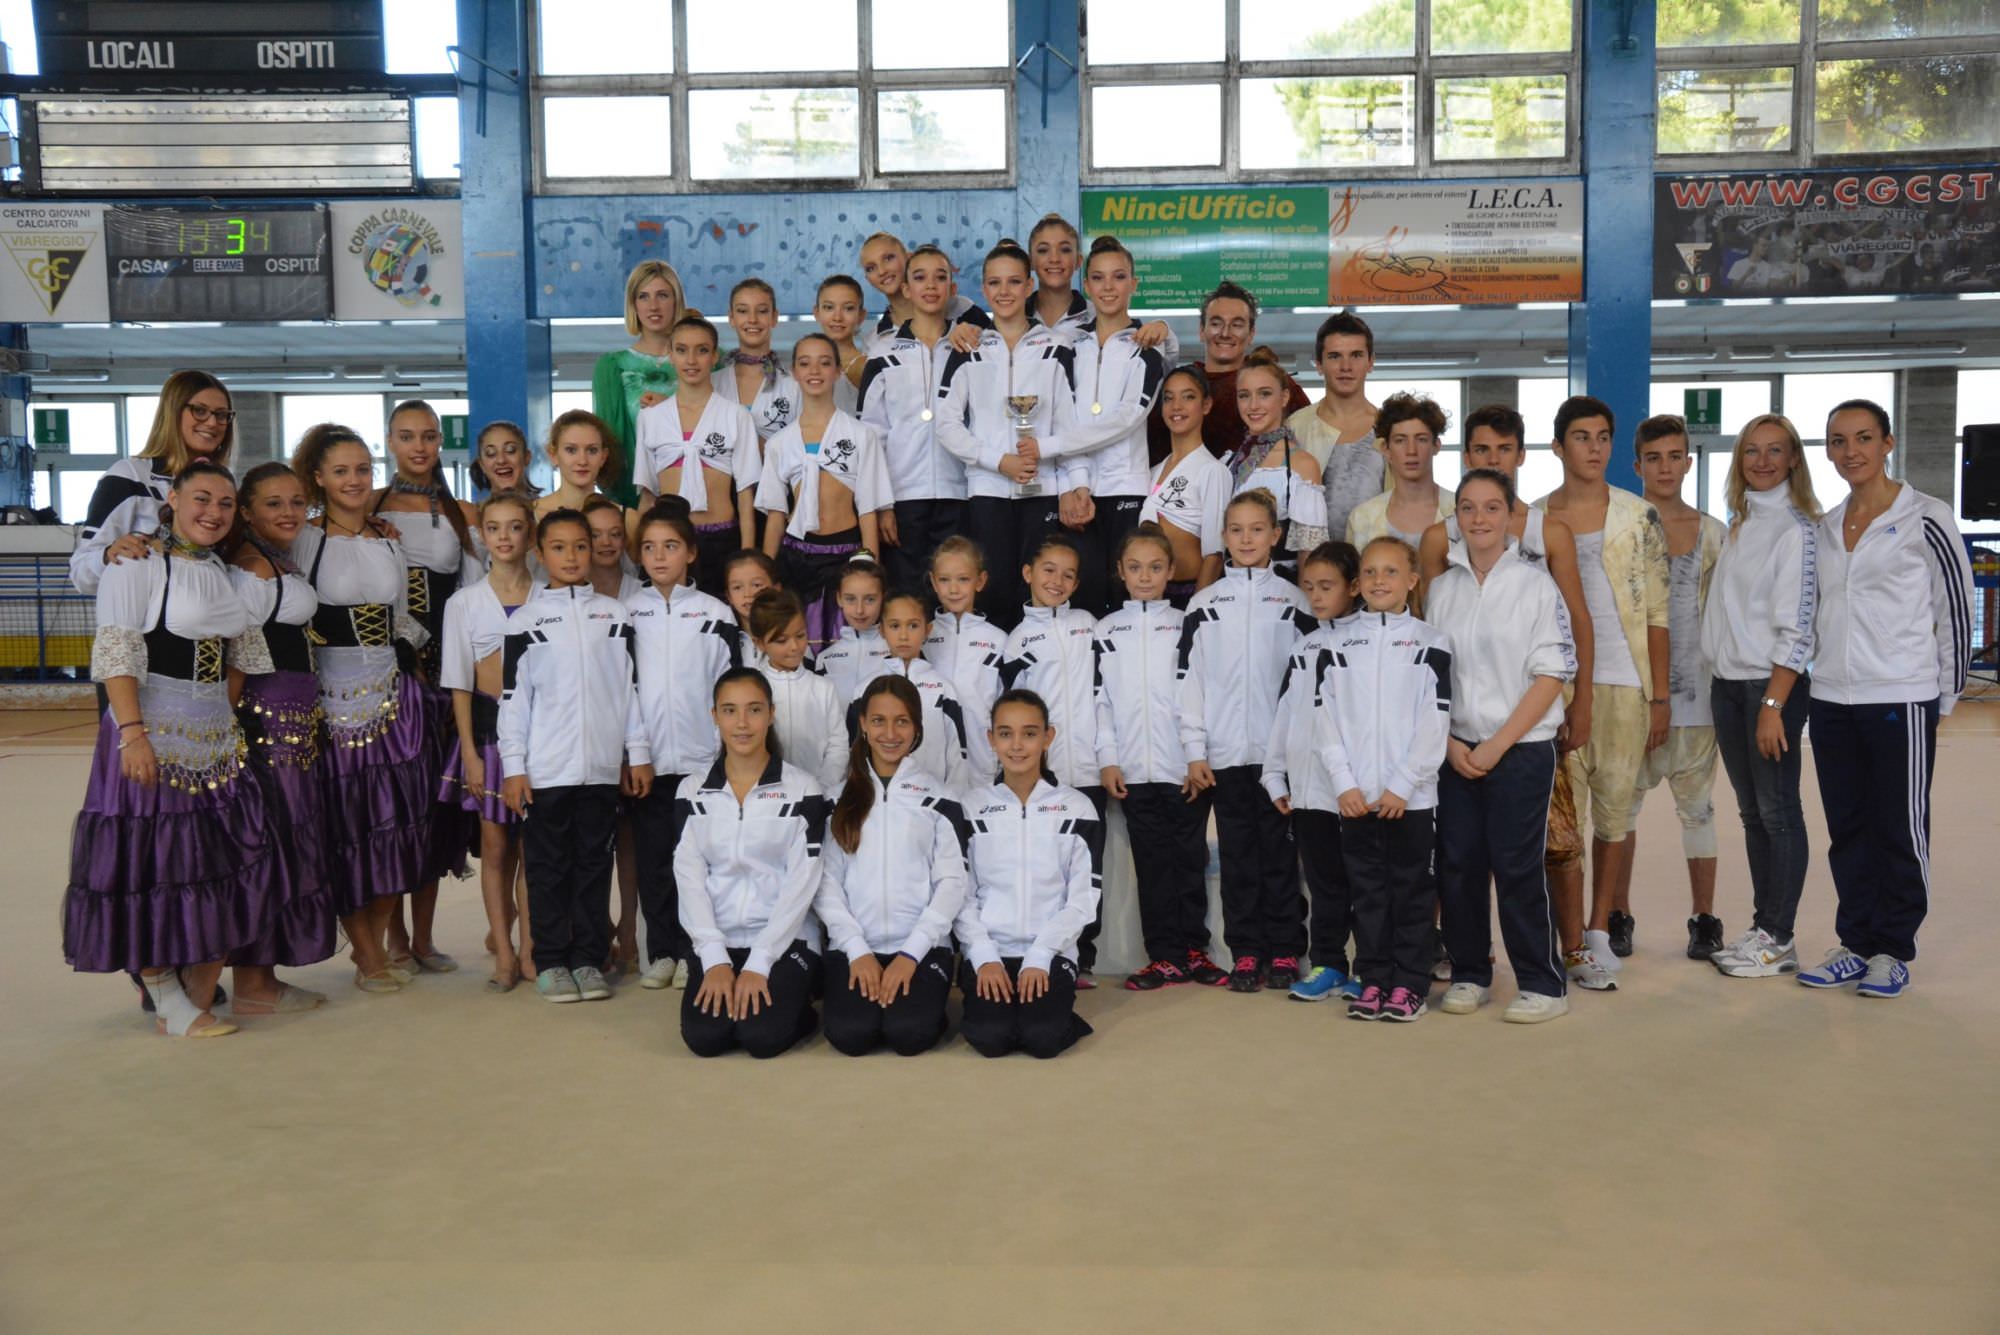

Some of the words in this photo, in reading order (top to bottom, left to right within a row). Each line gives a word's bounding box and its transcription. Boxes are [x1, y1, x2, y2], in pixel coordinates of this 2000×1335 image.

[88, 41, 175, 69] LOCALI
[257, 41, 335, 69] OSPITI
[1468, 188, 1562, 209] L.E.C.A.
[1670, 172, 2000, 208] WWW.CGCST
[3, 209, 46, 218] CENTRO
[49, 208, 90, 218] GIOVANI
[1102, 194, 1297, 221] NinciUfficio
[17, 219, 78, 229] CALCIATORI
[348, 214, 382, 255] COPPA
[382, 208, 445, 255] CARNEVALE
[11, 235, 85, 247] VIAREGGIO
[118, 259, 165, 273] CASA
[265, 258, 319, 273] OSPITI
